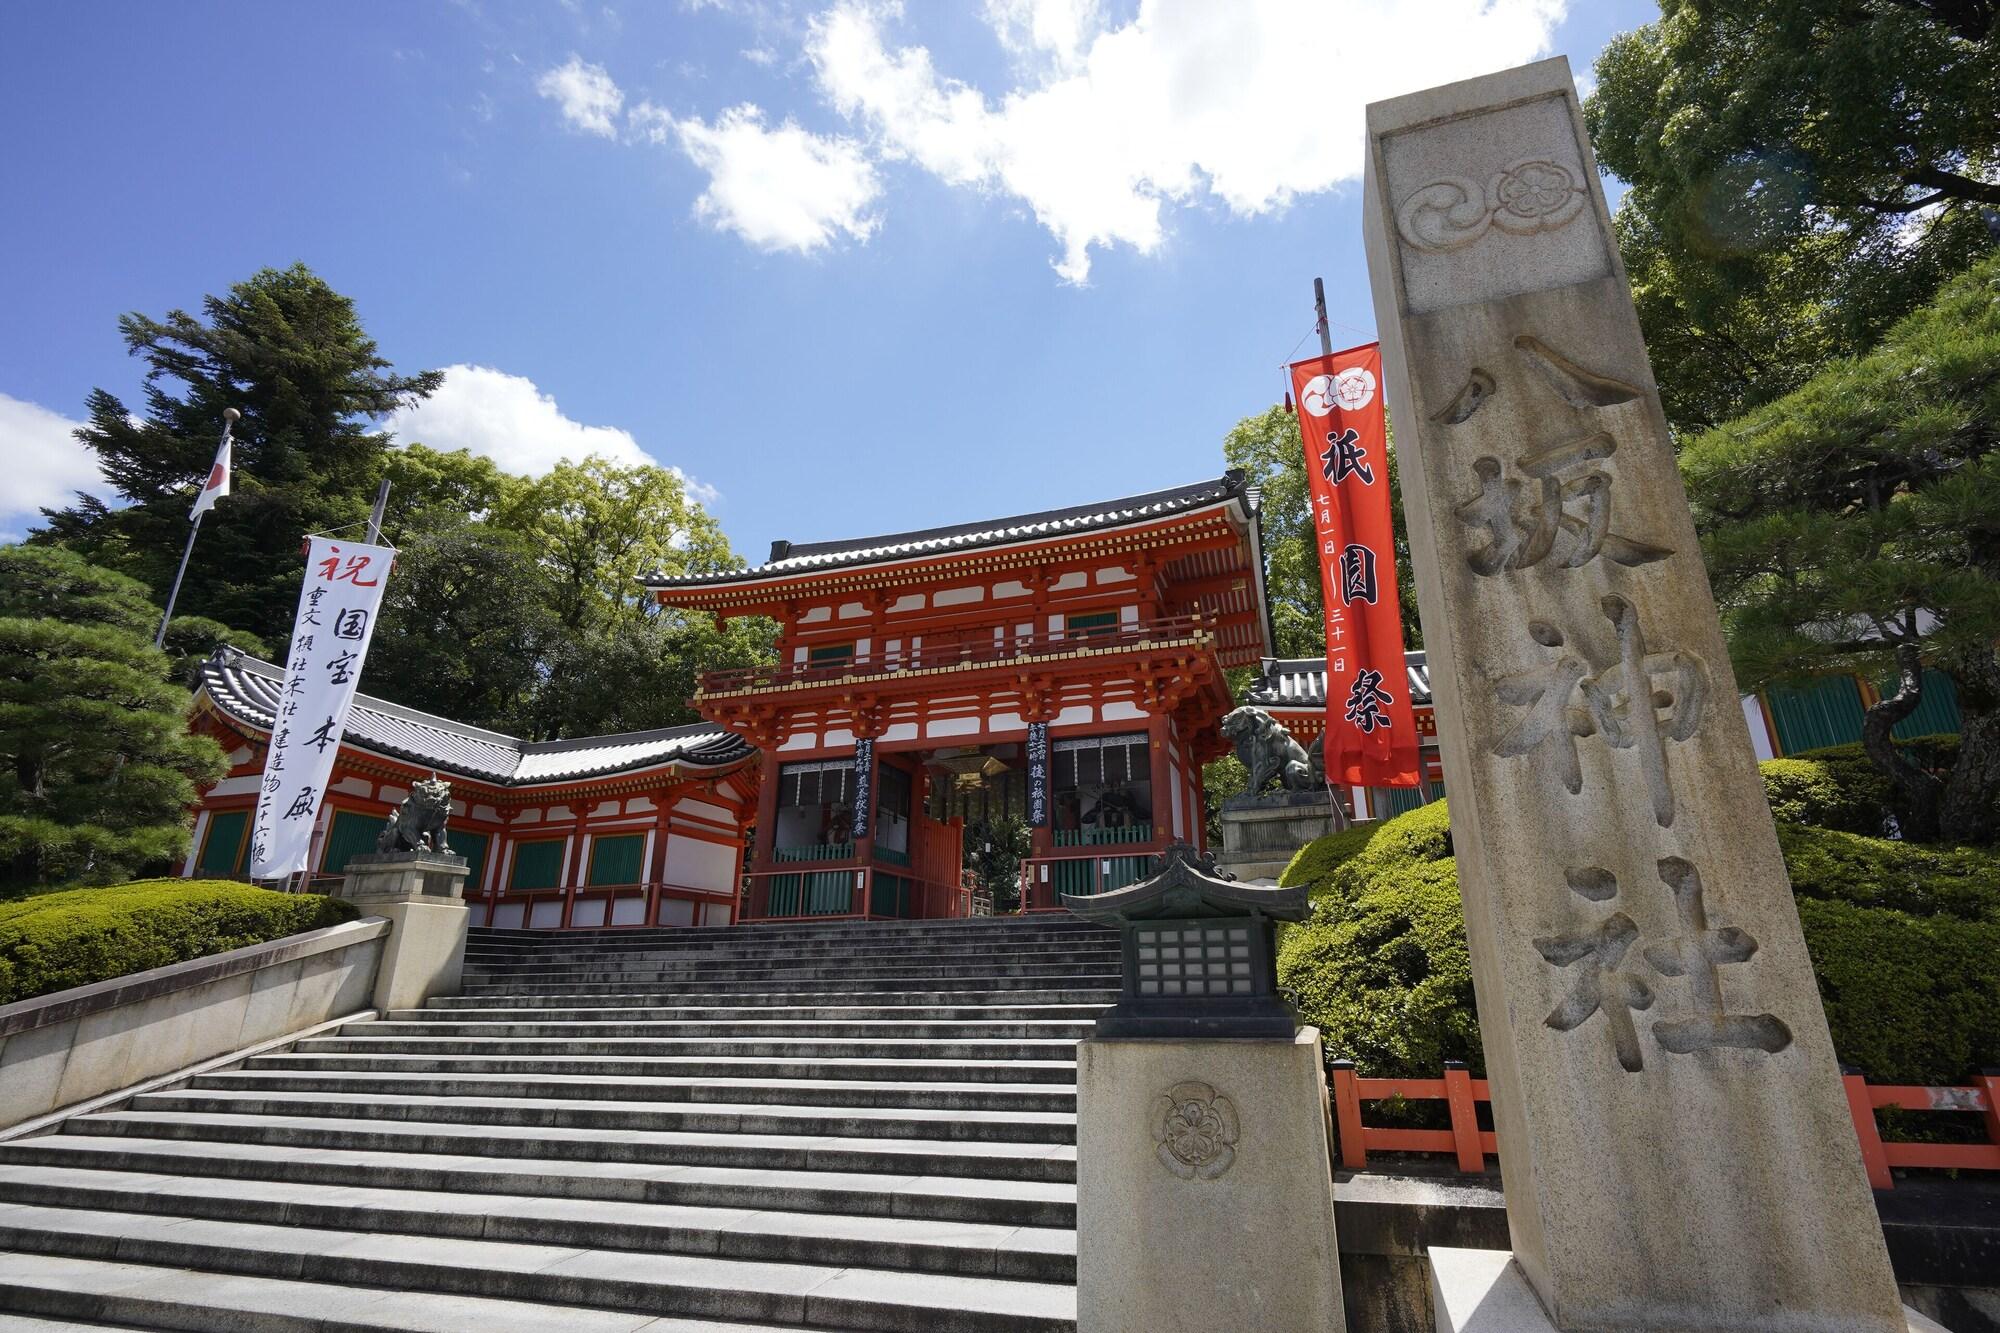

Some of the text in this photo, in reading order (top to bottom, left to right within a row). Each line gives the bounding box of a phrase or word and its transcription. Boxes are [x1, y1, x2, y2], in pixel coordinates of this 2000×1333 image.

[318, 546, 377, 587] 祝
[1319, 427, 1394, 735] 祇園祭
[282, 607, 369, 821] 国宝本殿
[1429, 335, 1794, 1073] 八坂神社
